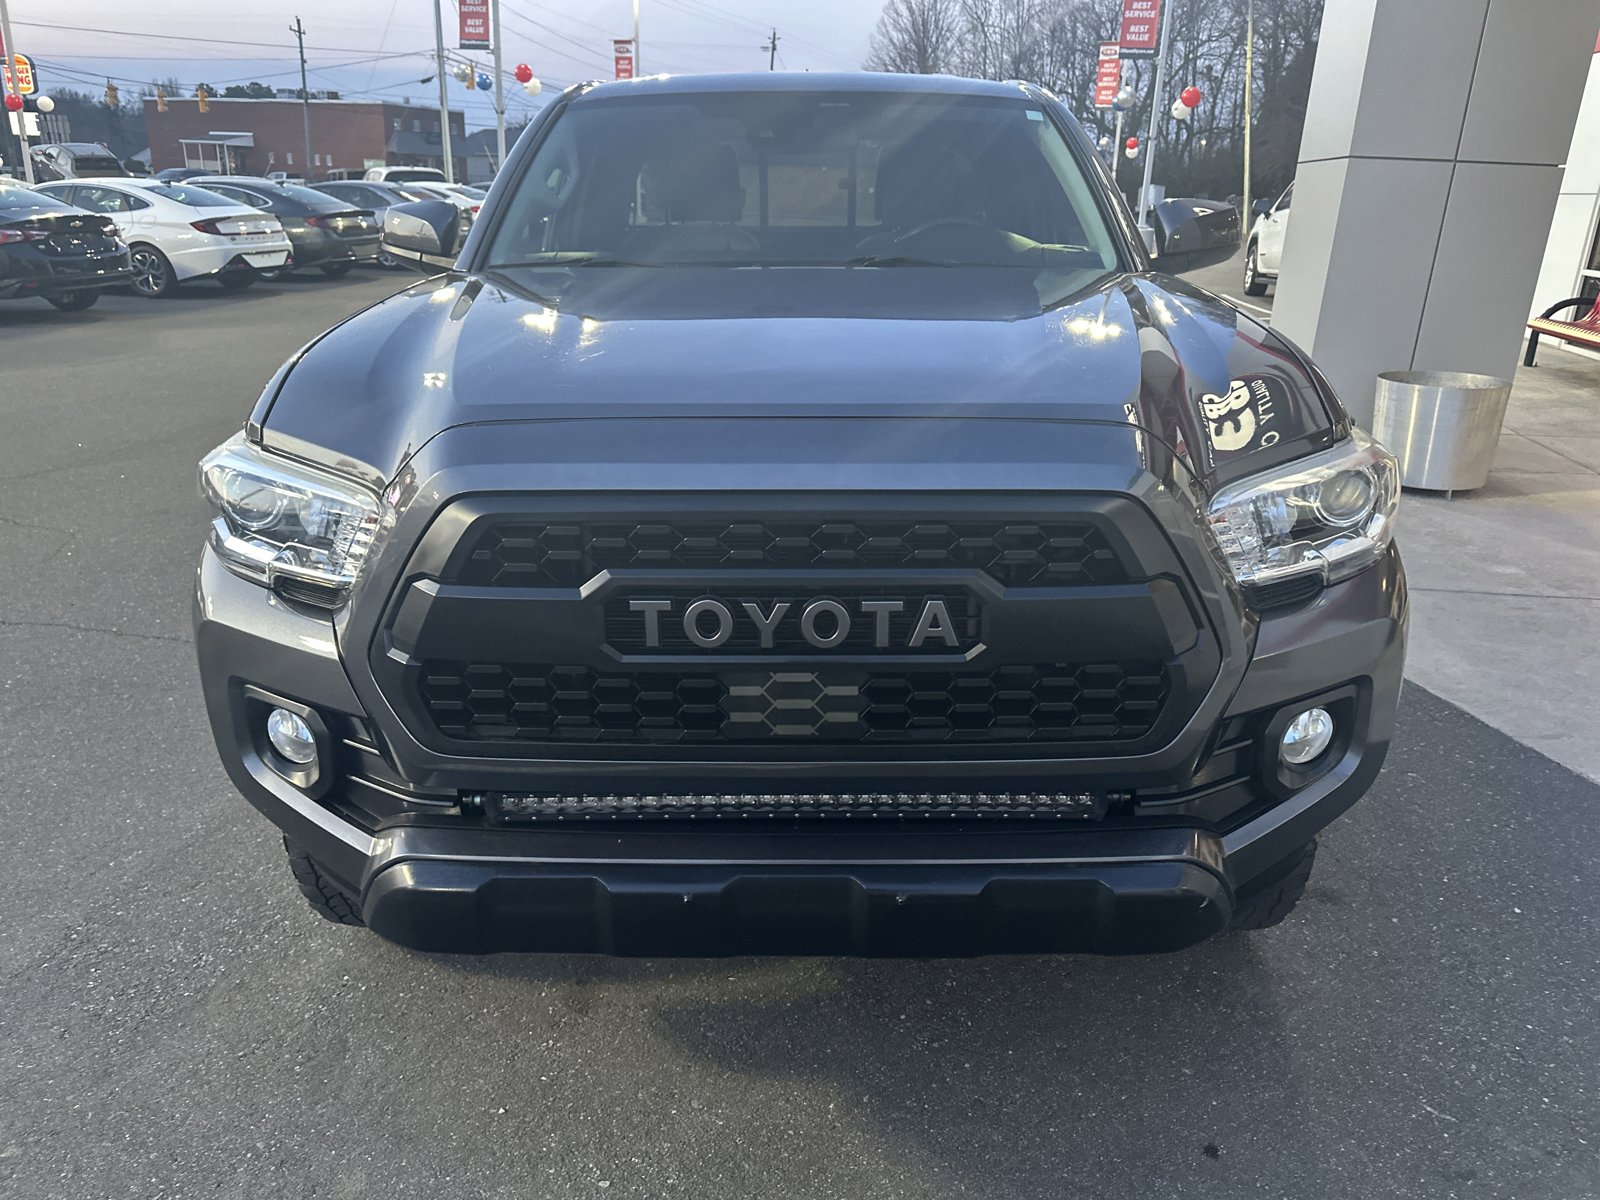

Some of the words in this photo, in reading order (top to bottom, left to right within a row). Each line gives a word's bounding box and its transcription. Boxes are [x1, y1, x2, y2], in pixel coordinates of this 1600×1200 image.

[1124, 10, 1156, 18] SERVICE
[6, 75, 31, 85] KNG
[629, 599, 959, 648] TOYOTA
